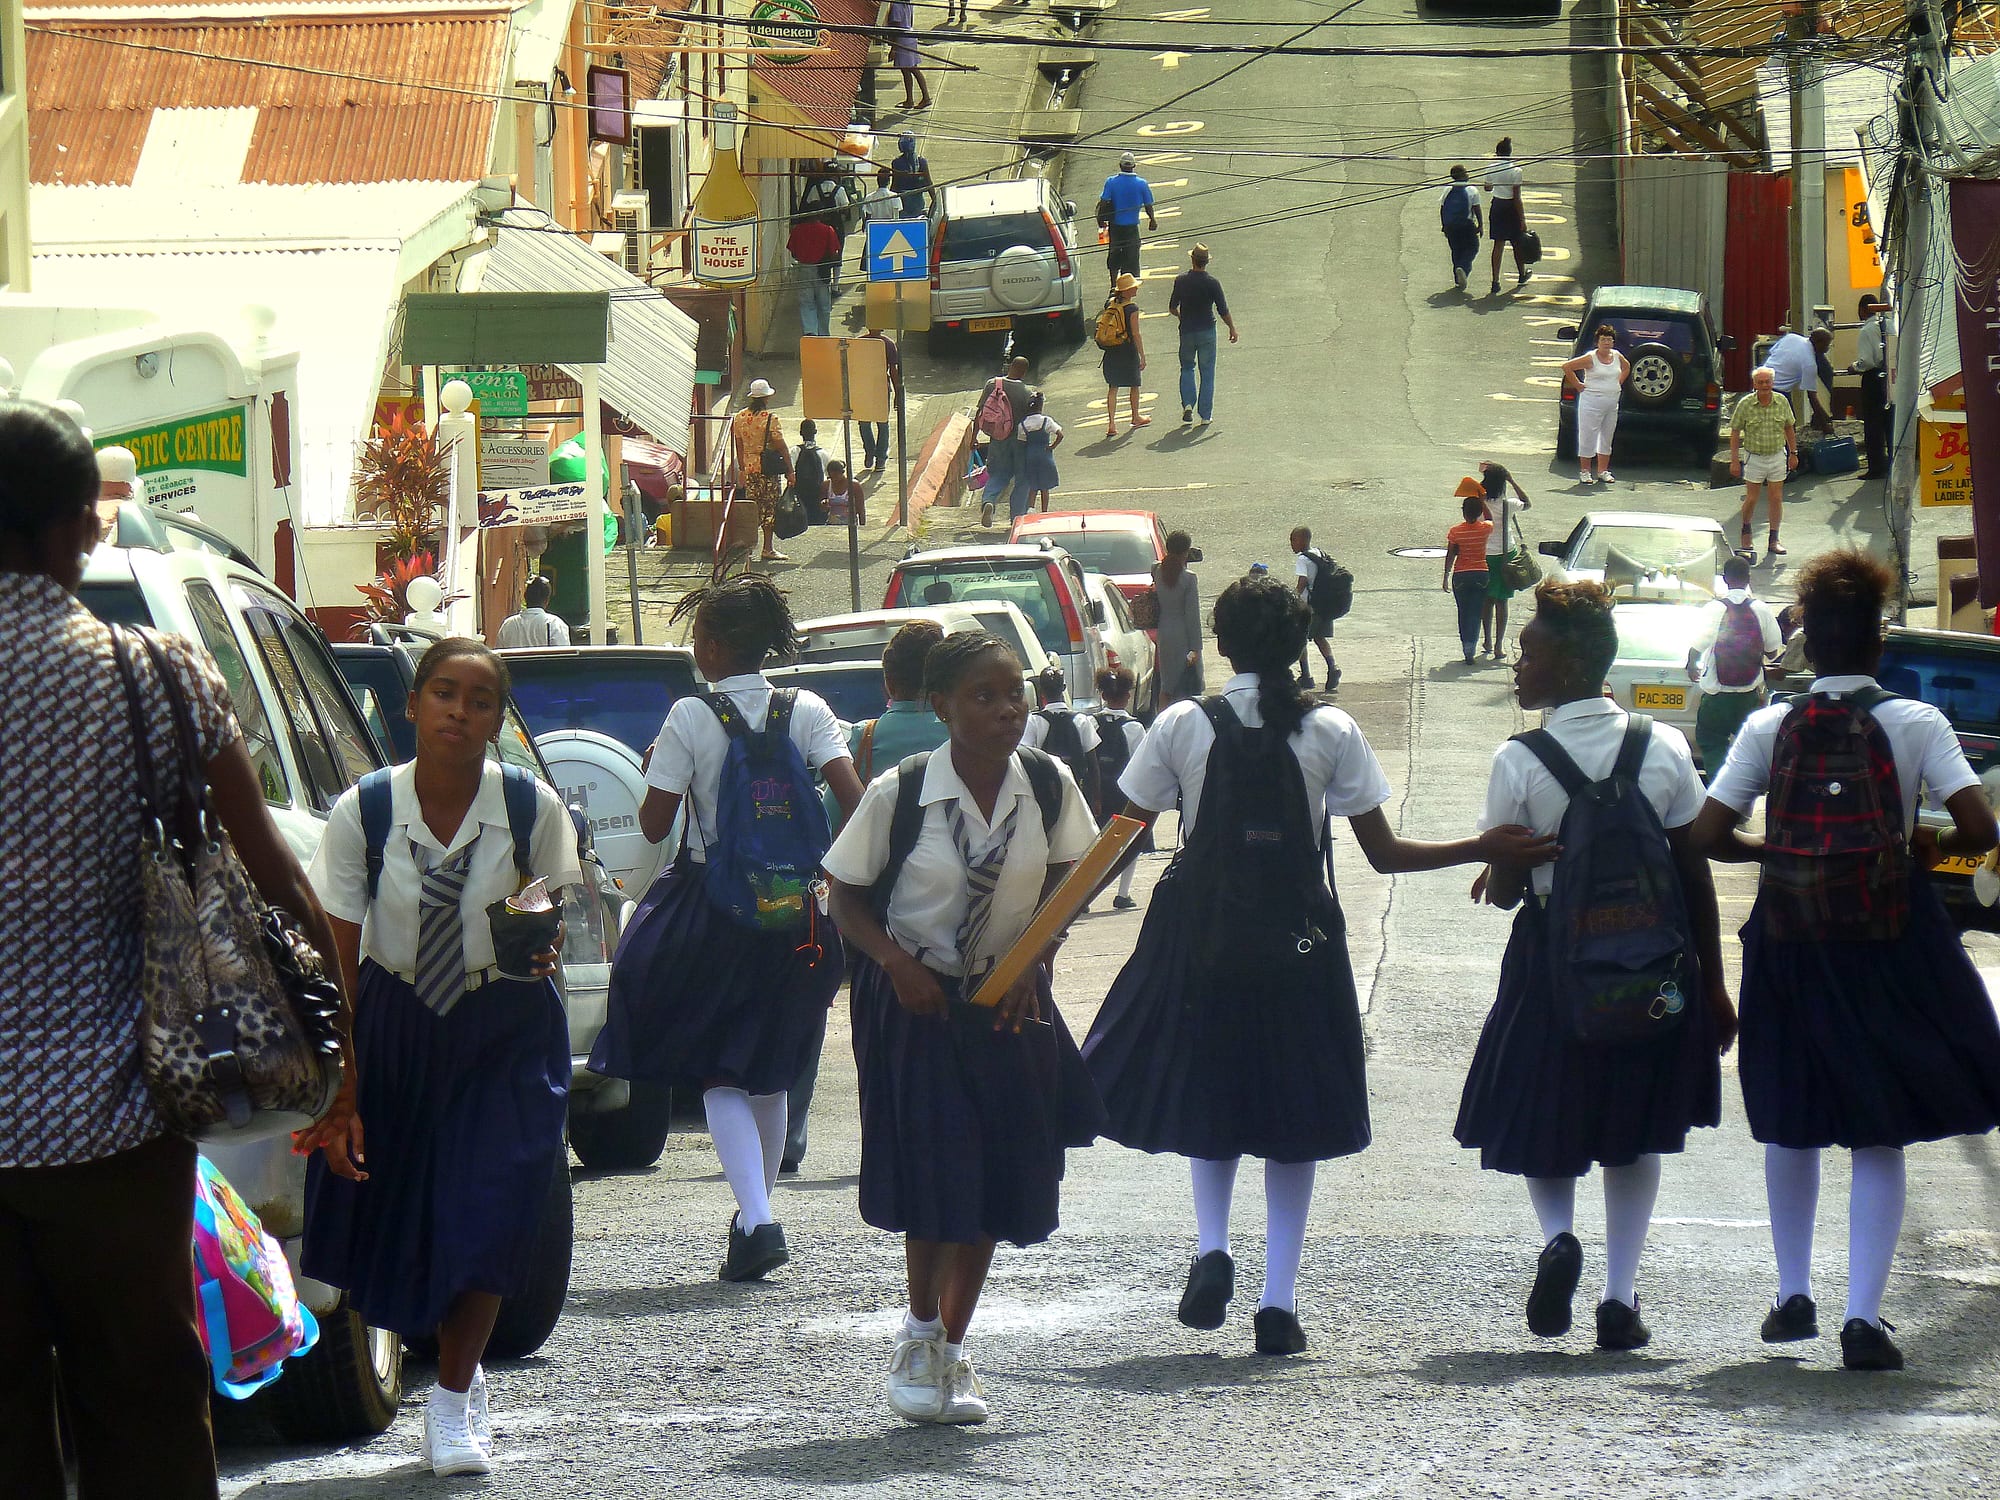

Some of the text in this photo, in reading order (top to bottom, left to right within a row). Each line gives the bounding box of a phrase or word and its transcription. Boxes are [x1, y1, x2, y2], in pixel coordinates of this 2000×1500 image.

[757, 25, 813, 38] Heineken
[713, 237, 737, 246] THE
[701, 245, 749, 256] BOTTLE
[703, 257, 745, 268] HOUSE
[1002, 277, 1042, 285] HONDA
[479, 390, 521, 399] SALON
[174, 414, 243, 463] CENTRE
[488, 443, 545, 456] ACCESSORIES
[1936, 479, 1952, 489] THE
[148, 485, 196, 504] SERVICES
[1934, 490, 1965, 502] LADIES
[953, 573, 1034, 584] FIELDTOURER
[1639, 692, 1684, 705] PAC 388
